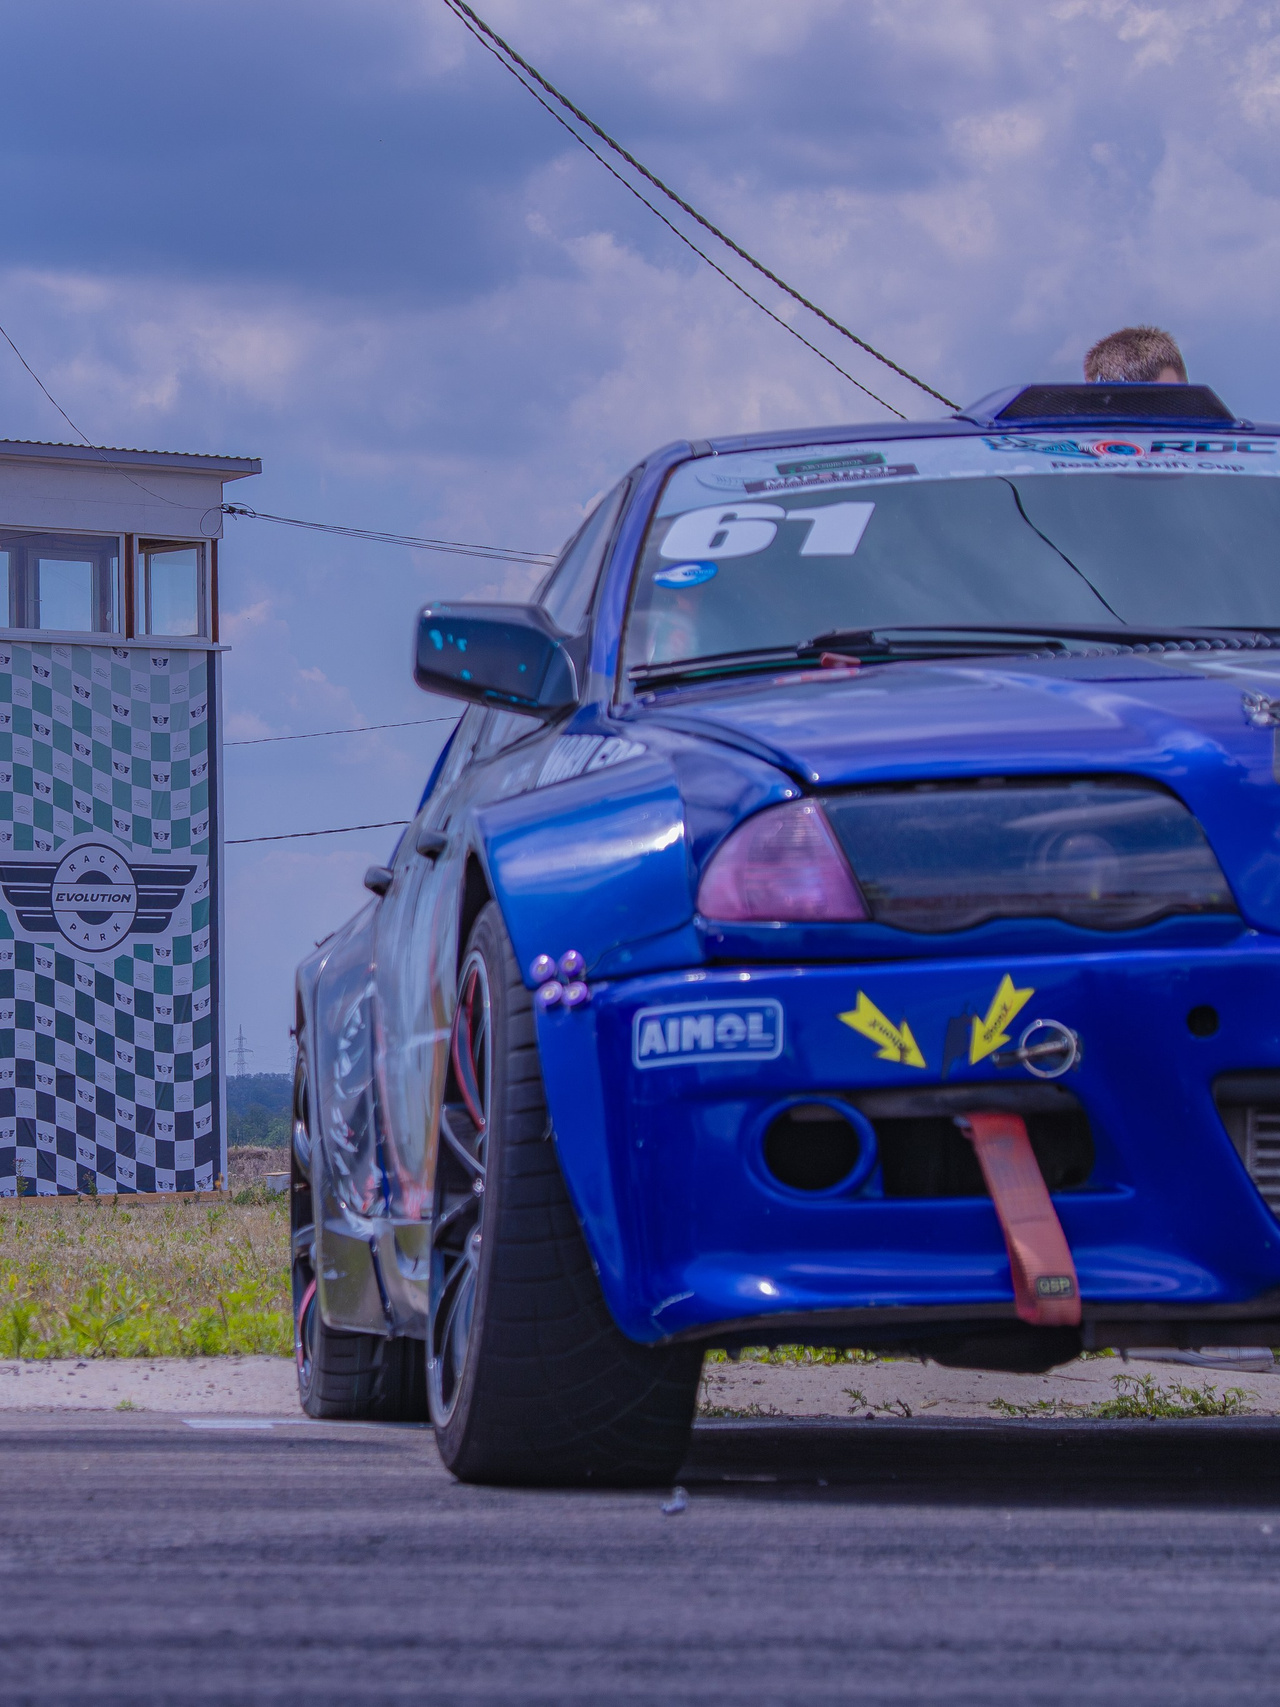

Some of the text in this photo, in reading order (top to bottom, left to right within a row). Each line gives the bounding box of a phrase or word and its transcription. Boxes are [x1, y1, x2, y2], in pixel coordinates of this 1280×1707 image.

[1150, 439, 1276, 453] RDC
[1050, 459, 1246, 472] Rostov Drift Cup
[660, 501, 876, 560] 61
[68, 855, 120, 873] RACE
[55, 893, 131, 903] EVOLUTION
[69, 922, 120, 942] PARK
[639, 1011, 775, 1057] AIMOL
